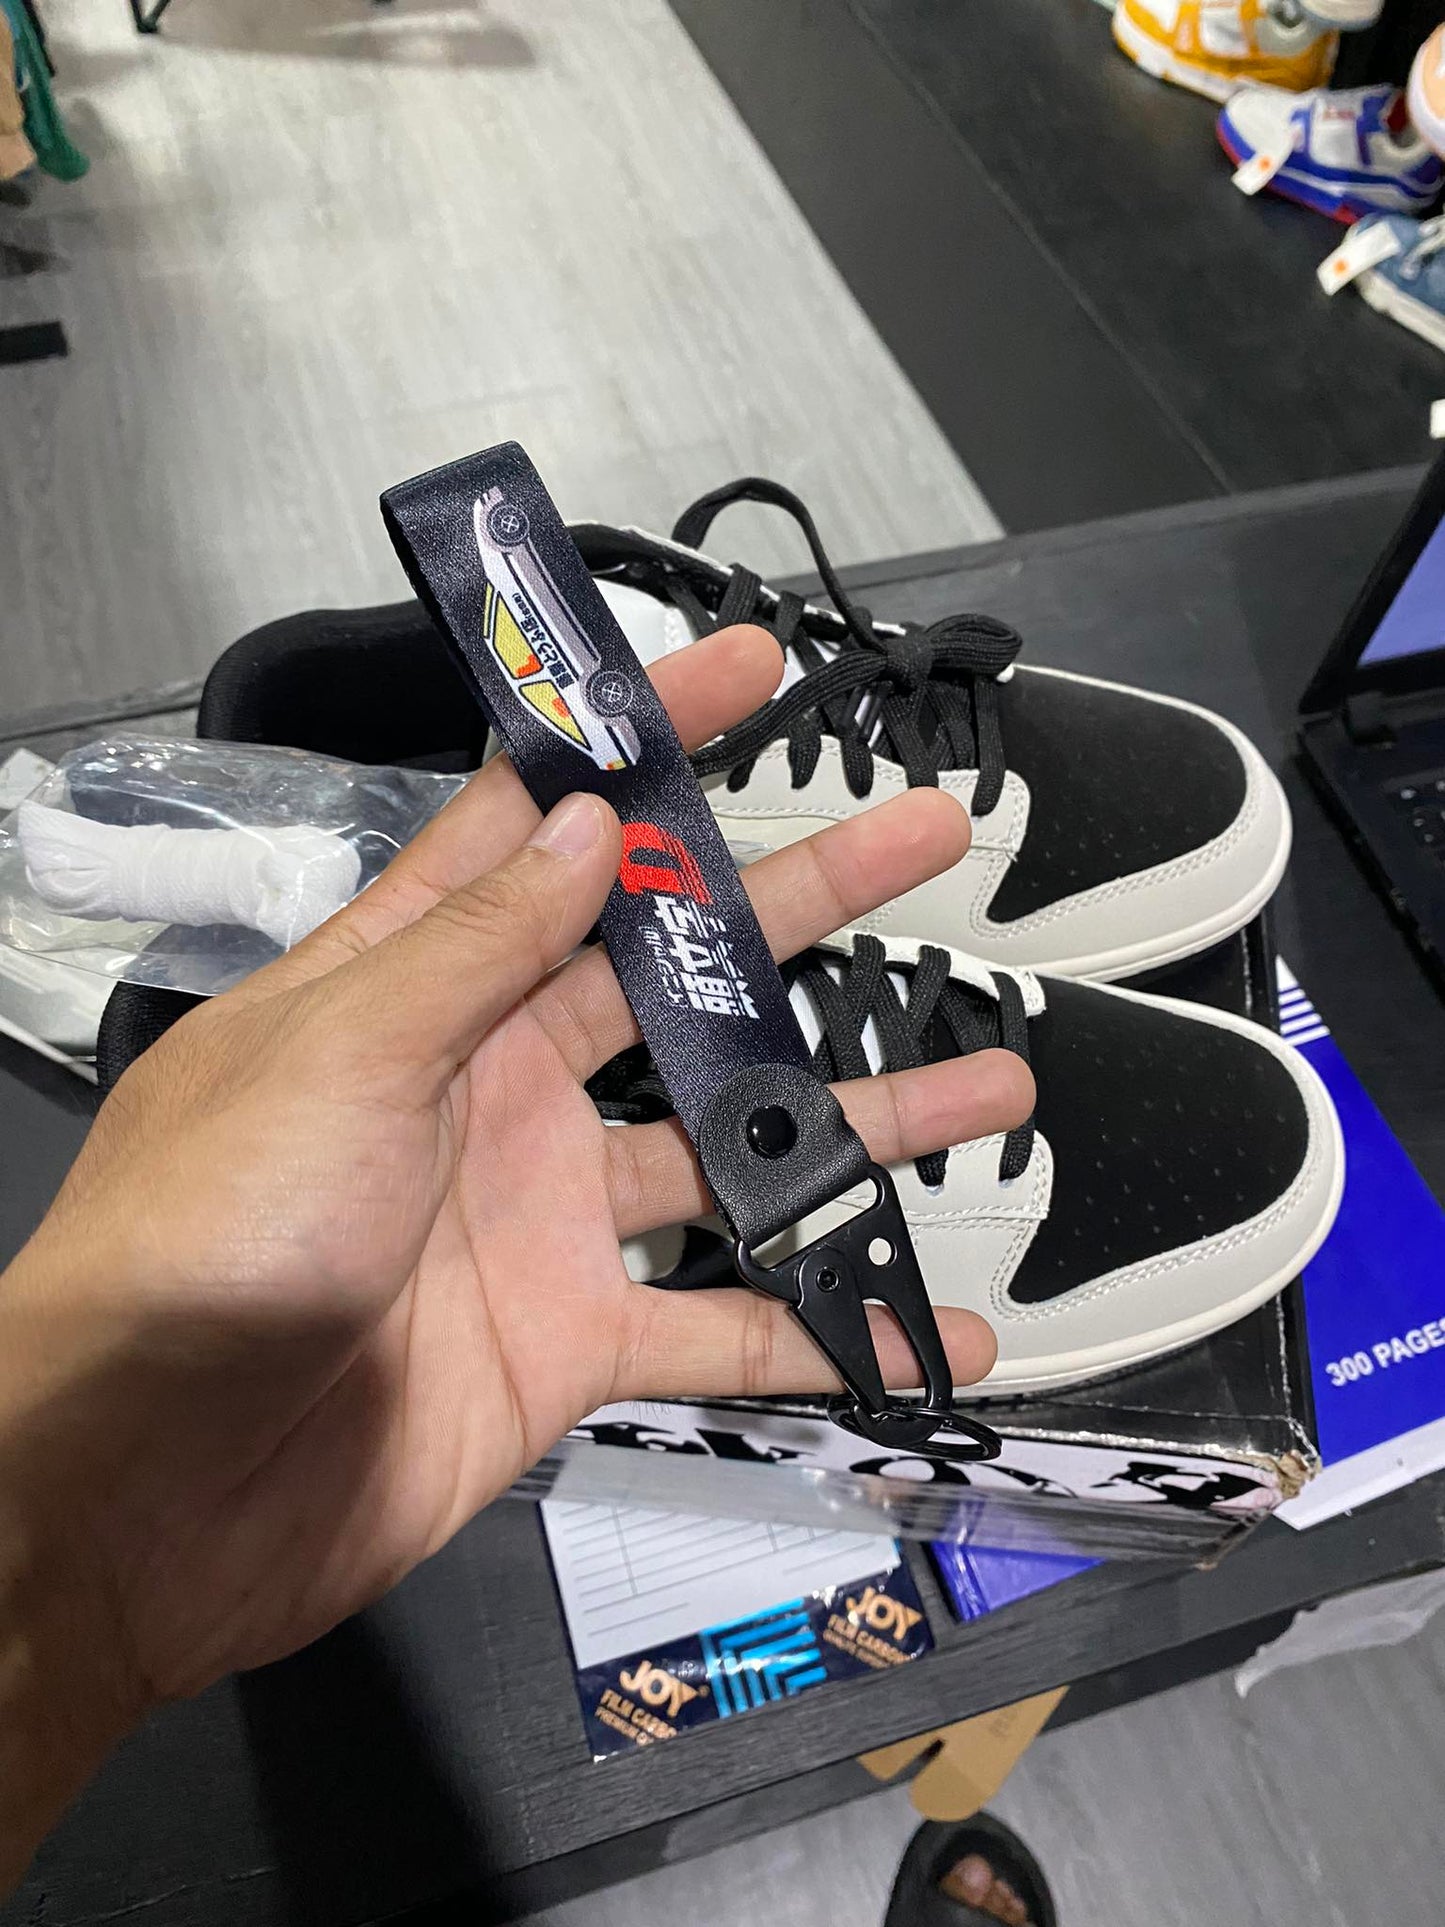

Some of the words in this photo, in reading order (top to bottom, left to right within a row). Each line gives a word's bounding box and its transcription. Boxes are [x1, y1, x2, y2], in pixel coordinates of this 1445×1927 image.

[1325, 1351, 1375, 1386] 300
[846, 1585, 922, 1640] JOY
[619, 1660, 698, 1718] JOY
